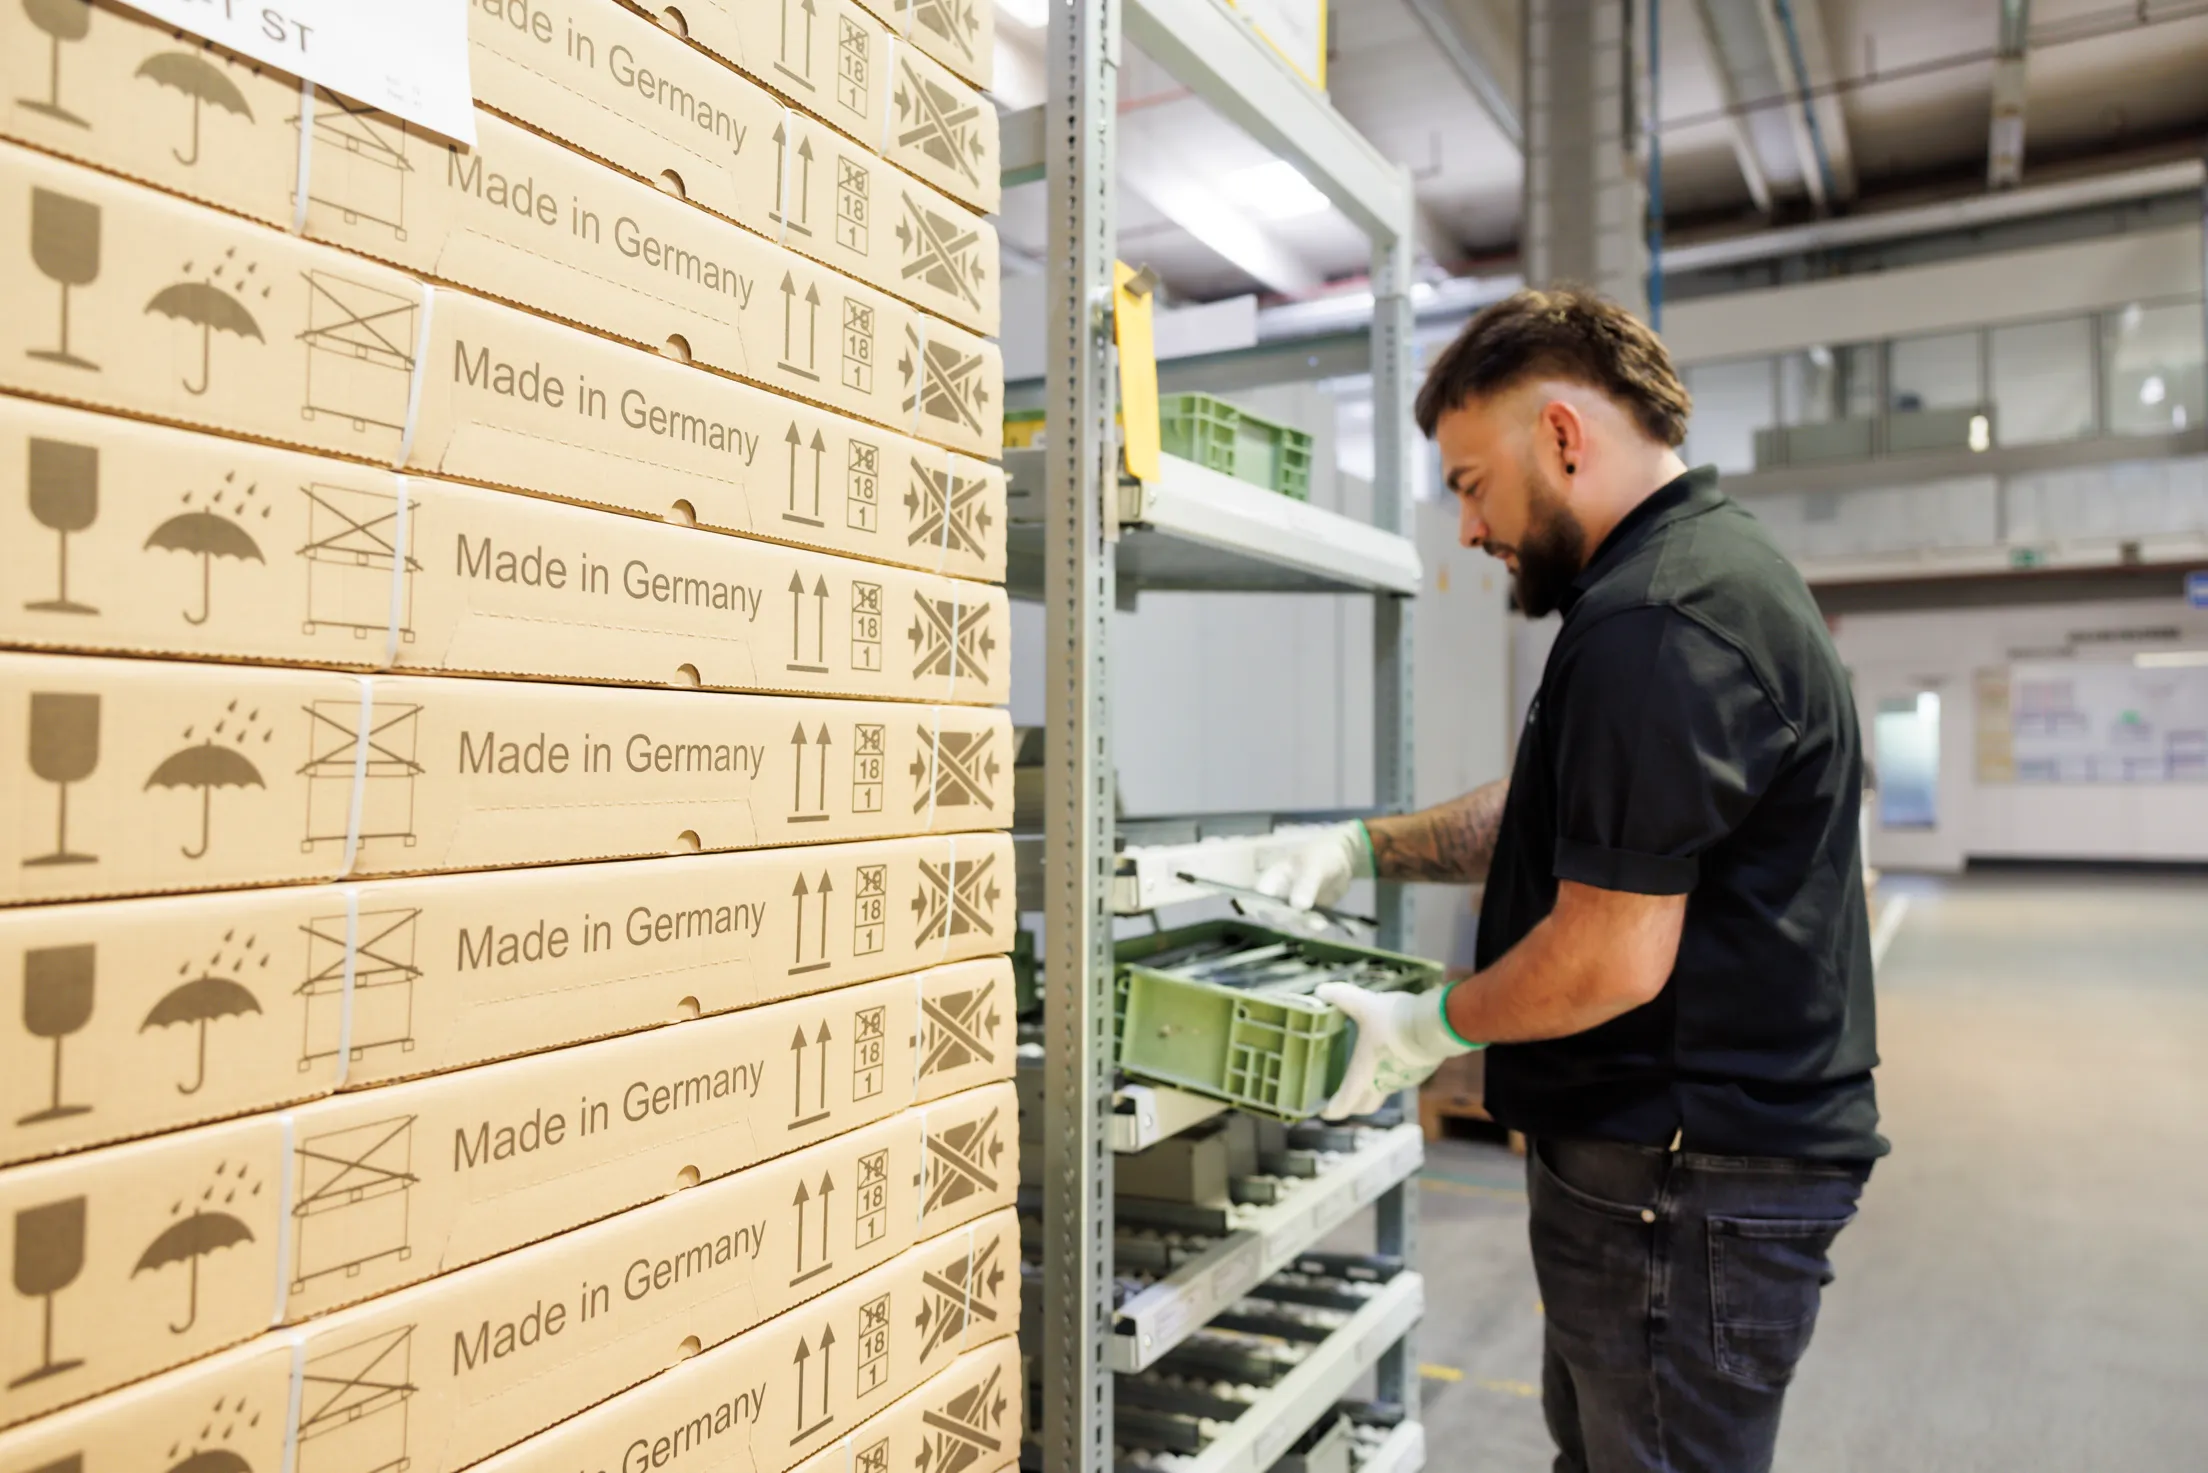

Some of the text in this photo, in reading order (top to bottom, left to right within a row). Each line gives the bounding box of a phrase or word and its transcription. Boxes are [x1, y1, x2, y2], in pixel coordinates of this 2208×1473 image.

[261, 8, 314, 52] ST
[473, 0, 748, 155] ade in Germany
[845, 55, 863, 83] 18
[849, 87, 856, 109] 1
[844, 195, 863, 221] 18
[447, 145, 753, 313] Made in Germany
[848, 226, 856, 248] 1
[850, 335, 868, 359] 18
[853, 365, 861, 387] 1
[455, 340, 759, 466] Made in Germany
[854, 476, 873, 499] 18
[858, 506, 866, 527] 1
[457, 533, 762, 622] Made in Germany
[858, 617, 877, 638] 18
[863, 646, 870, 668] 1
[460, 731, 764, 780] Made in Germany
[860, 759, 879, 779] 18
[864, 787, 872, 809] 1
[862, 899, 881, 921] 18
[458, 902, 766, 971] Made in Germany
[865, 928, 873, 951] 1
[861, 1041, 879, 1065] 18
[864, 1072, 872, 1094] 1
[454, 1060, 764, 1172] Made in Germany
[863, 1185, 882, 1211] 18
[867, 1217, 875, 1239] 1
[454, 1220, 766, 1376] Made in Germany
[865, 1331, 884, 1359] 18
[869, 1365, 878, 1387] 1
[622, 1382, 766, 1473] Germany
